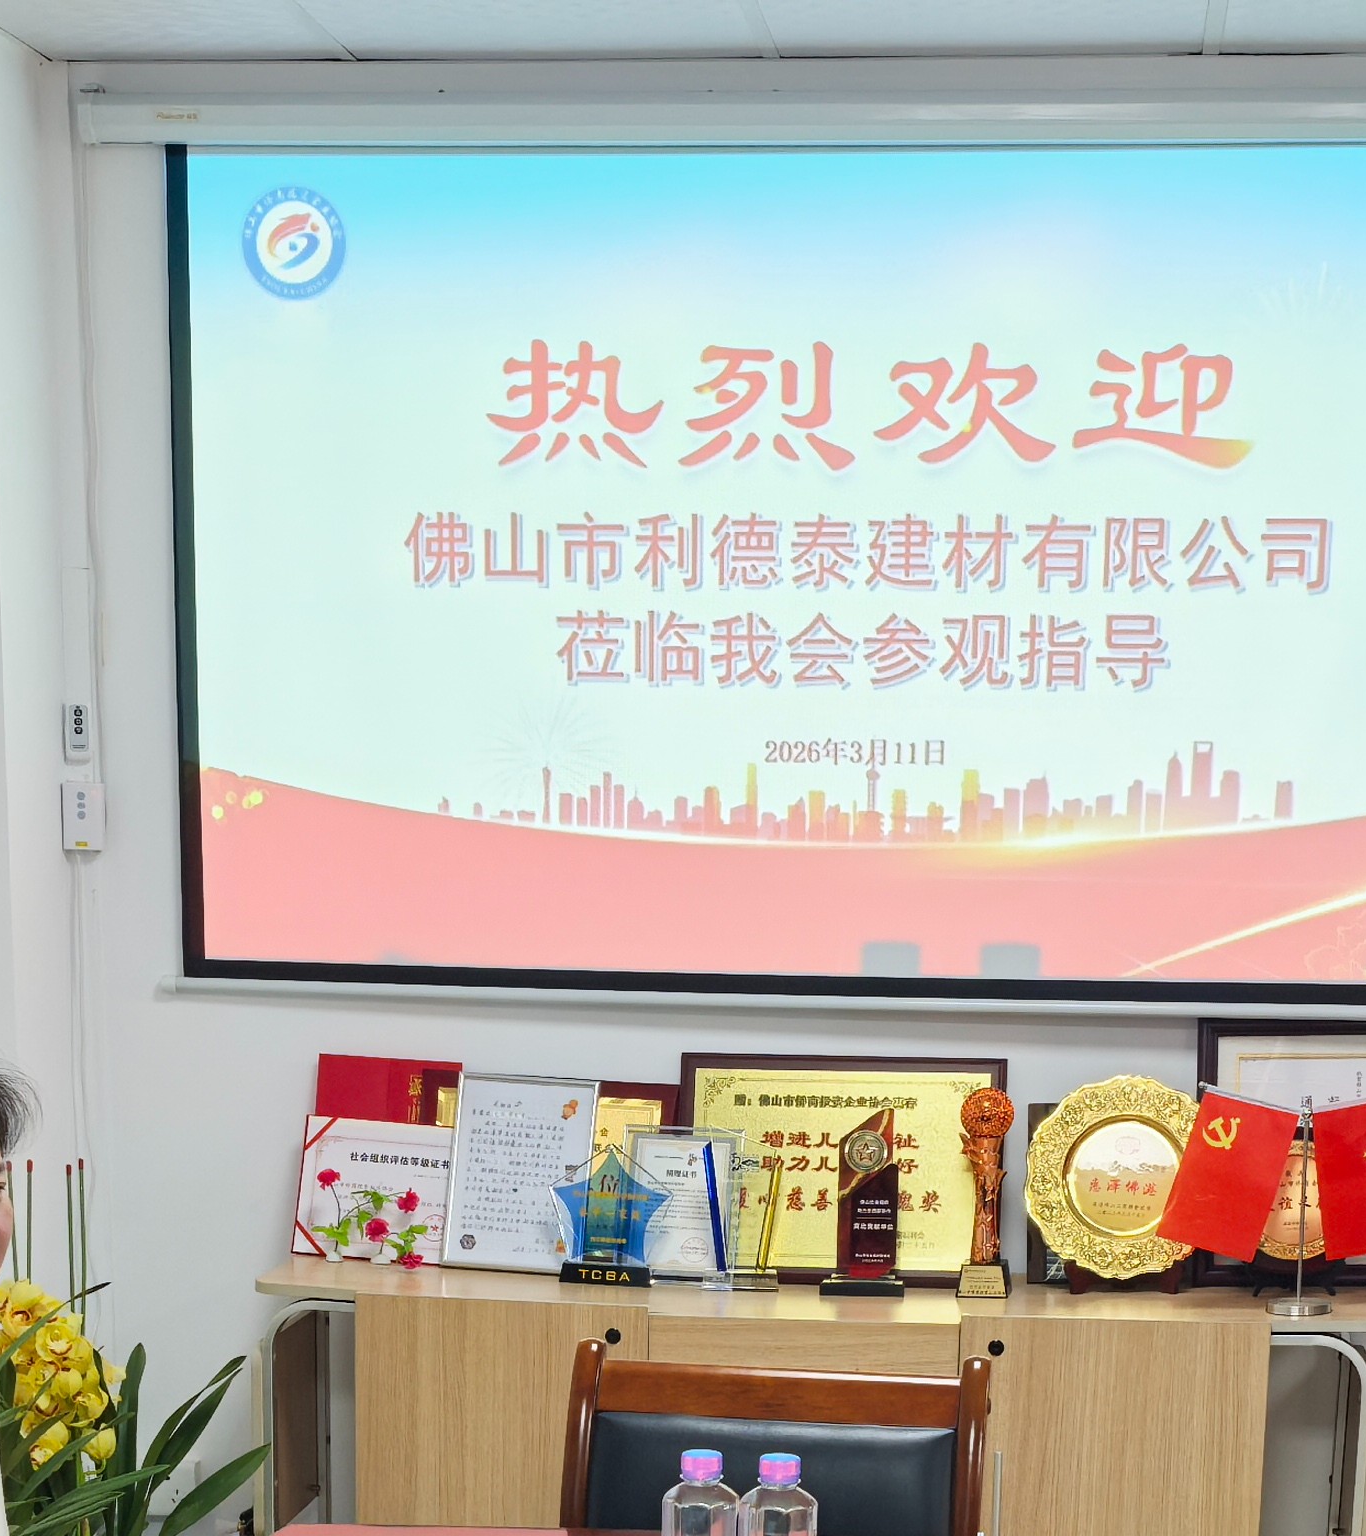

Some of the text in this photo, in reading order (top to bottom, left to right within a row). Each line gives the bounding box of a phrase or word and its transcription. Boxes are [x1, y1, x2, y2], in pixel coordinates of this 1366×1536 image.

[487, 338, 1255, 471] 热烈欢迎
[403, 510, 1334, 595] 佛山市利德泰建材有限公司
[555, 610, 1171, 693] 莅临我会参观指导
[764, 737, 945, 766] 2026年3月11日
[760, 1131, 920, 1150] 增进儿祉
[349, 1152, 450, 1170] 社会组织评估等级证书
[761, 1155, 919, 1175] 助力儿好
[578, 1269, 630, 1282] TCBA
